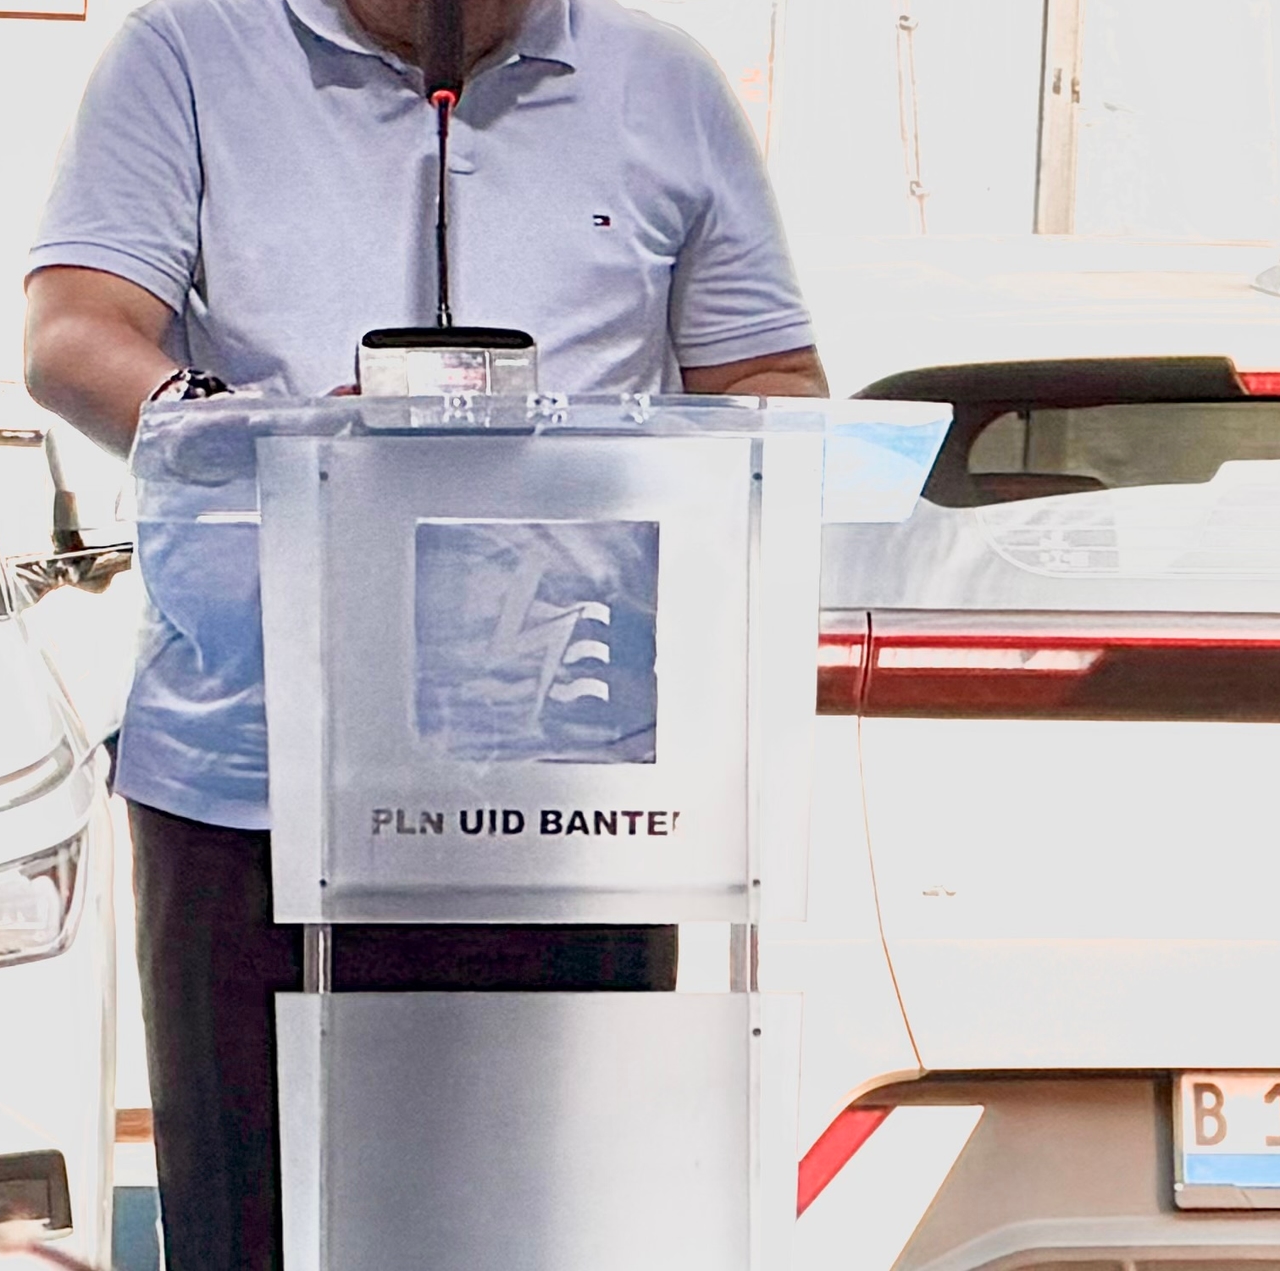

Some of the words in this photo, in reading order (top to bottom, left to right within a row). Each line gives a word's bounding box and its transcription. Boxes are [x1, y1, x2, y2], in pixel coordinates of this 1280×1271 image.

[372, 809, 444, 834] PLN
[460, 809, 525, 835] UID
[1193, 1082, 1227, 1147] B
